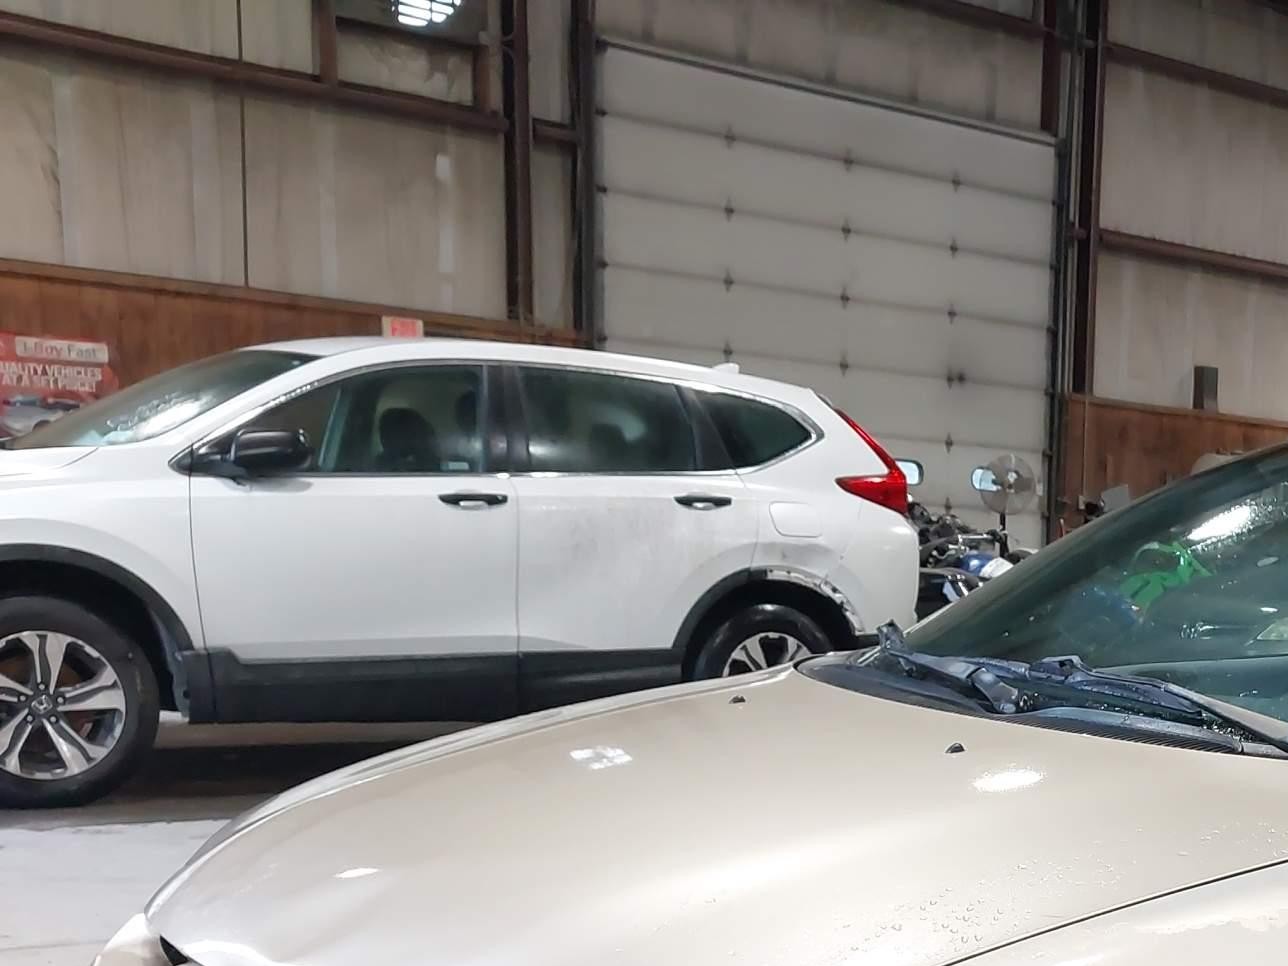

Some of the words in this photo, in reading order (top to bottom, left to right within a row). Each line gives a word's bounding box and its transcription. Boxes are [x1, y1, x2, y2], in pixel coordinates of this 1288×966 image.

[67, 344, 97, 358] Fast
[0, 361, 43, 377] UALITY
[45, 364, 102, 381] VEHICLES
